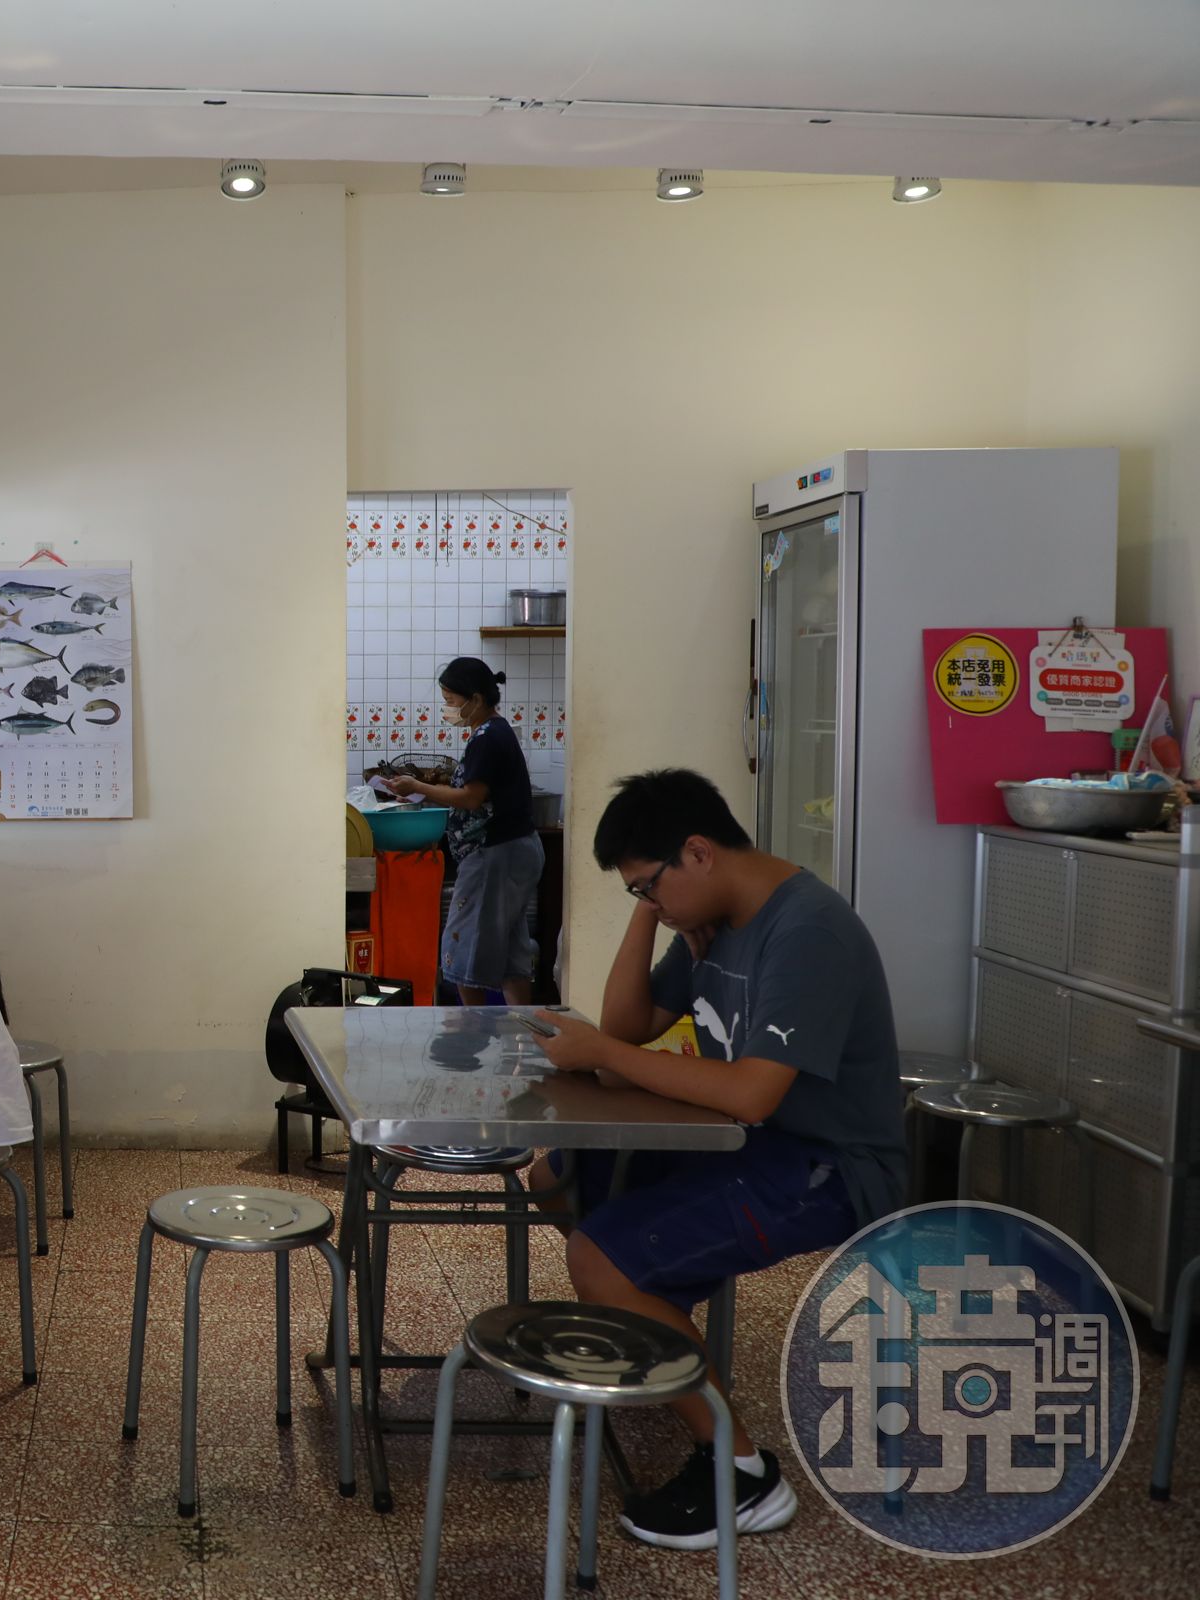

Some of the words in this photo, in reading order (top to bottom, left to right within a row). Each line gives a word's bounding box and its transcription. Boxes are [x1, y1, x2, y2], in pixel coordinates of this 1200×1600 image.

[947, 659, 1006, 673] 本店免用
[947, 673, 1007, 687] 統一發票
[1046, 674, 1117, 688] 優質商家認證
